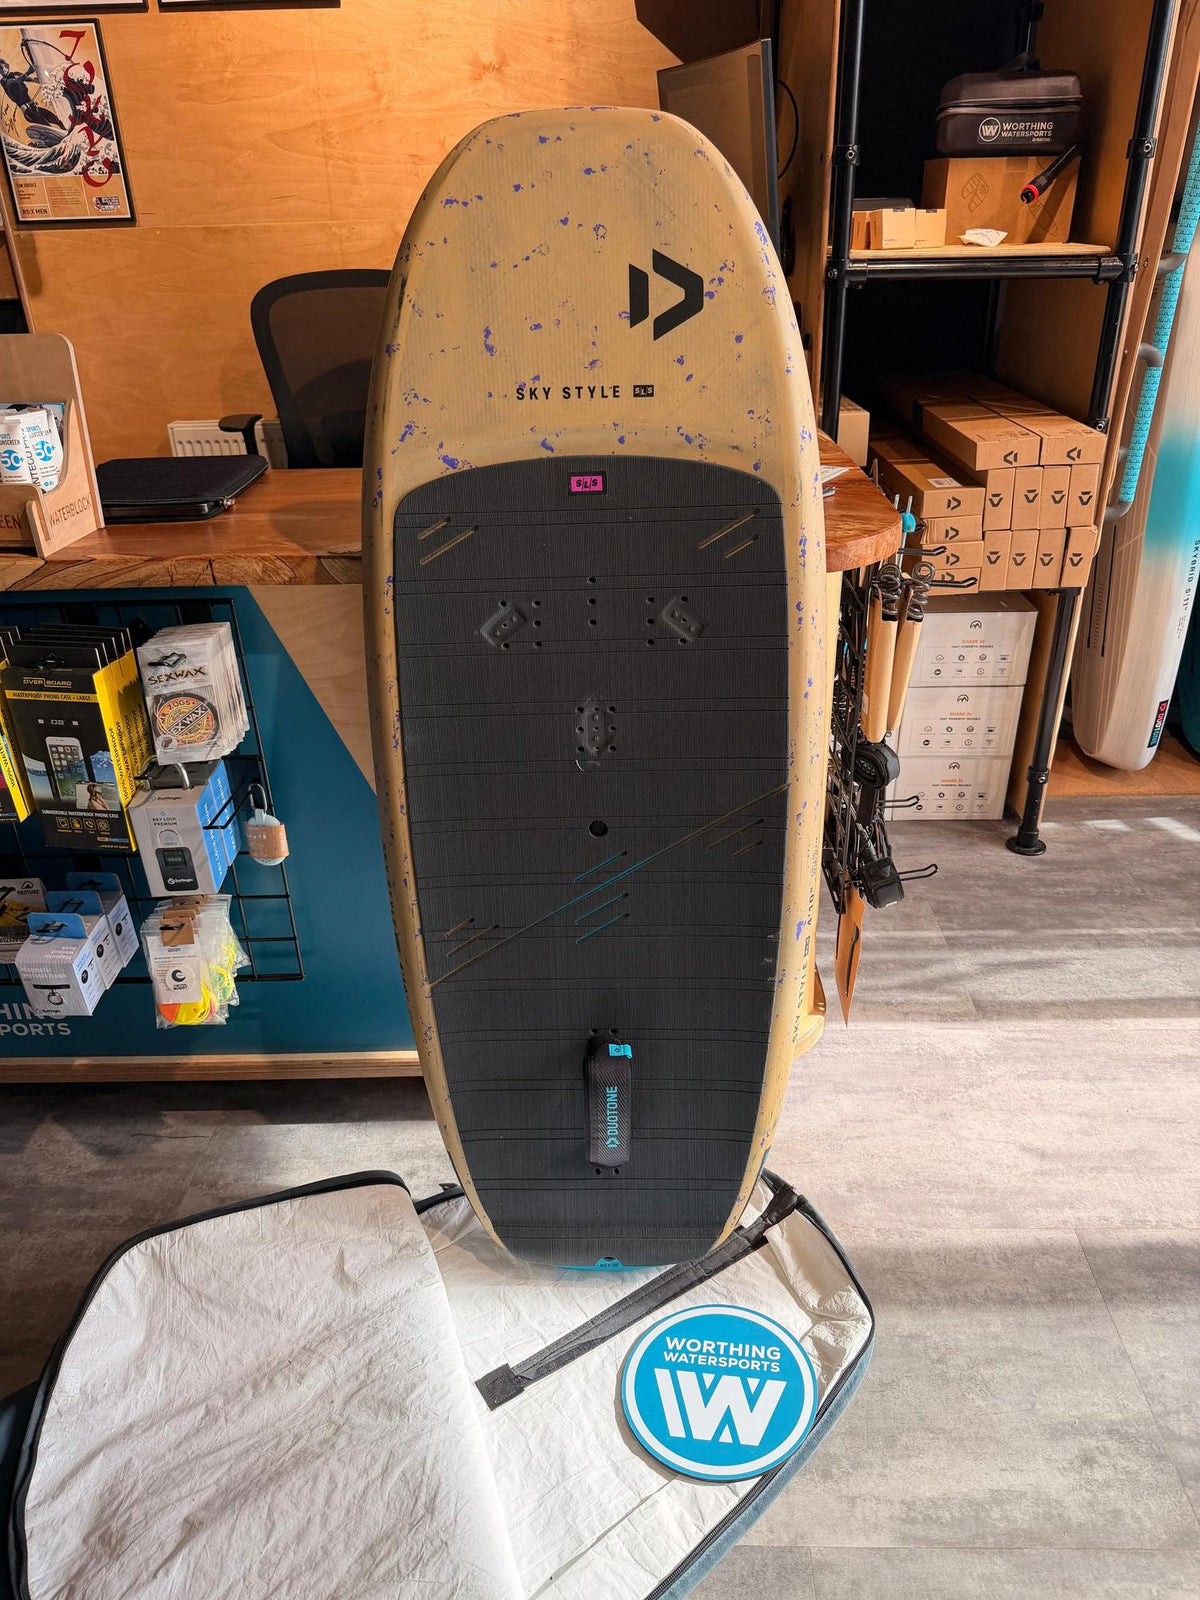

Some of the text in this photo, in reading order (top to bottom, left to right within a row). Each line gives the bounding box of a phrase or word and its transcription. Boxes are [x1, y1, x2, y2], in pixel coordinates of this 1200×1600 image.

[1002, 122, 1054, 130] WORTHING
[516, 386, 552, 400] SKY
[562, 386, 620, 400] STYLE
[49, 495, 92, 528] WATERBLOCK
[1187, 539, 1200, 583] SKYBRID
[147, 666, 206, 686] SEXWAX
[1150, 711, 1165, 746] DUOTONE
[109, 727, 126, 779] WATERPROOF
[116, 721, 131, 776] WATERPROOF
[0, 1002, 67, 1020] HIN
[606, 1086, 618, 1136] DUOTONE
[664, 1352, 780, 1372] WATERSPORTS
[666, 1336, 781, 1360] WORTHING
